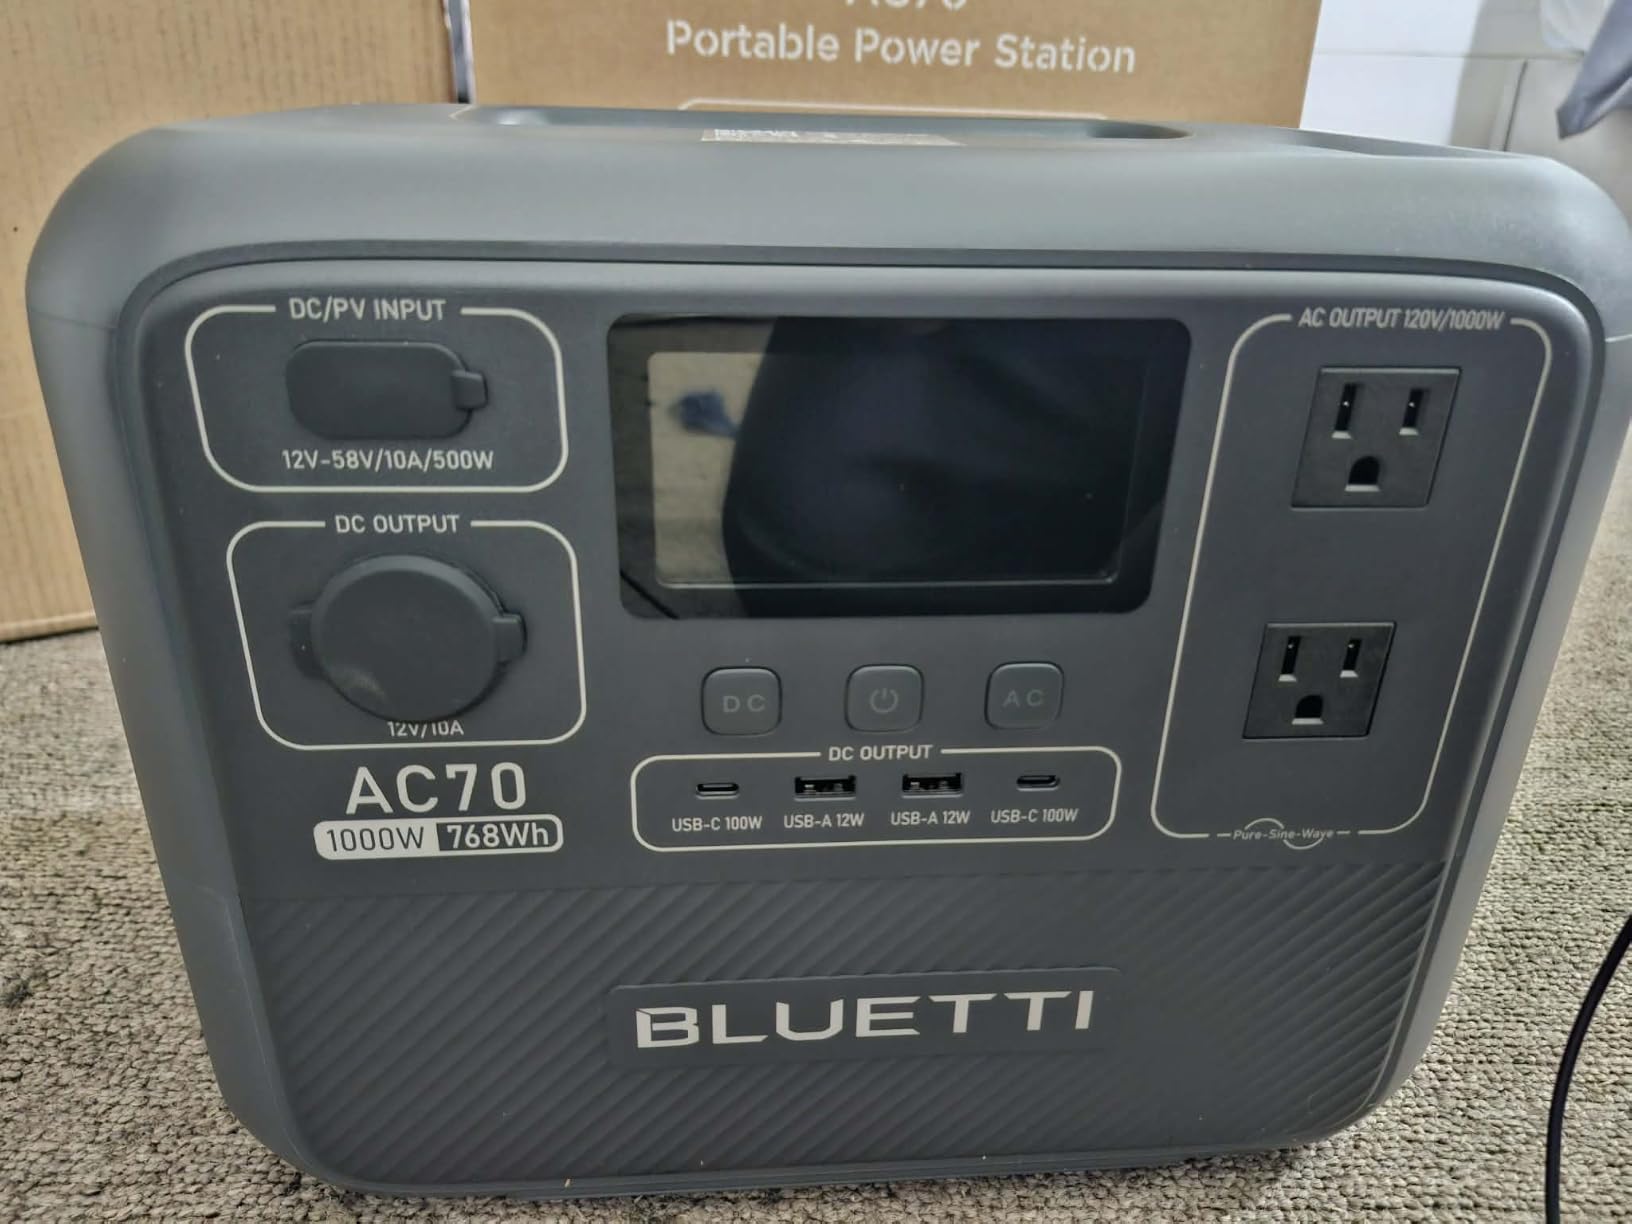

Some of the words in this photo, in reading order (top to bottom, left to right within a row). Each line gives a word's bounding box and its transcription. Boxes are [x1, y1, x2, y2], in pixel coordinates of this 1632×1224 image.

[666, 19, 840, 62] Portable
[854, 27, 980, 67] Power
[994, 33, 1136, 73] Station
[288, 296, 367, 323] DC/PV
[373, 298, 446, 321] INPUT
[1298, 307, 1327, 328] AC
[1329, 307, 1401, 329] OUTPUT
[1403, 309, 1506, 332] 120V/1000W
[282, 448, 494, 473] 12V-58V/10A/500W
[334, 514, 366, 534] DC
[372, 514, 460, 534] OUTPUT
[722, 693, 767, 713] DC
[1001, 688, 1044, 708] AC
[386, 719, 465, 740] 12V/10A
[828, 746, 854, 762] DC
[859, 744, 934, 762] OUTPUT
[345, 761, 527, 816] AC70
[671, 816, 721, 833] USB-C
[725, 815, 763, 831] 100W
[783, 814, 833, 829] USB-A
[836, 812, 865, 828] 12W
[890, 811, 938, 827] USB-A
[942, 809, 971, 825] 12W
[990, 808, 1038, 825] USB-C
[1042, 807, 1079, 823] 100W
[325, 825, 425, 853] 1000W
[445, 820, 550, 850] 768Wh
[1232, 827, 1335, 842] Pure-Sine-Wave
[635, 989, 1095, 1049] BLUETTI
